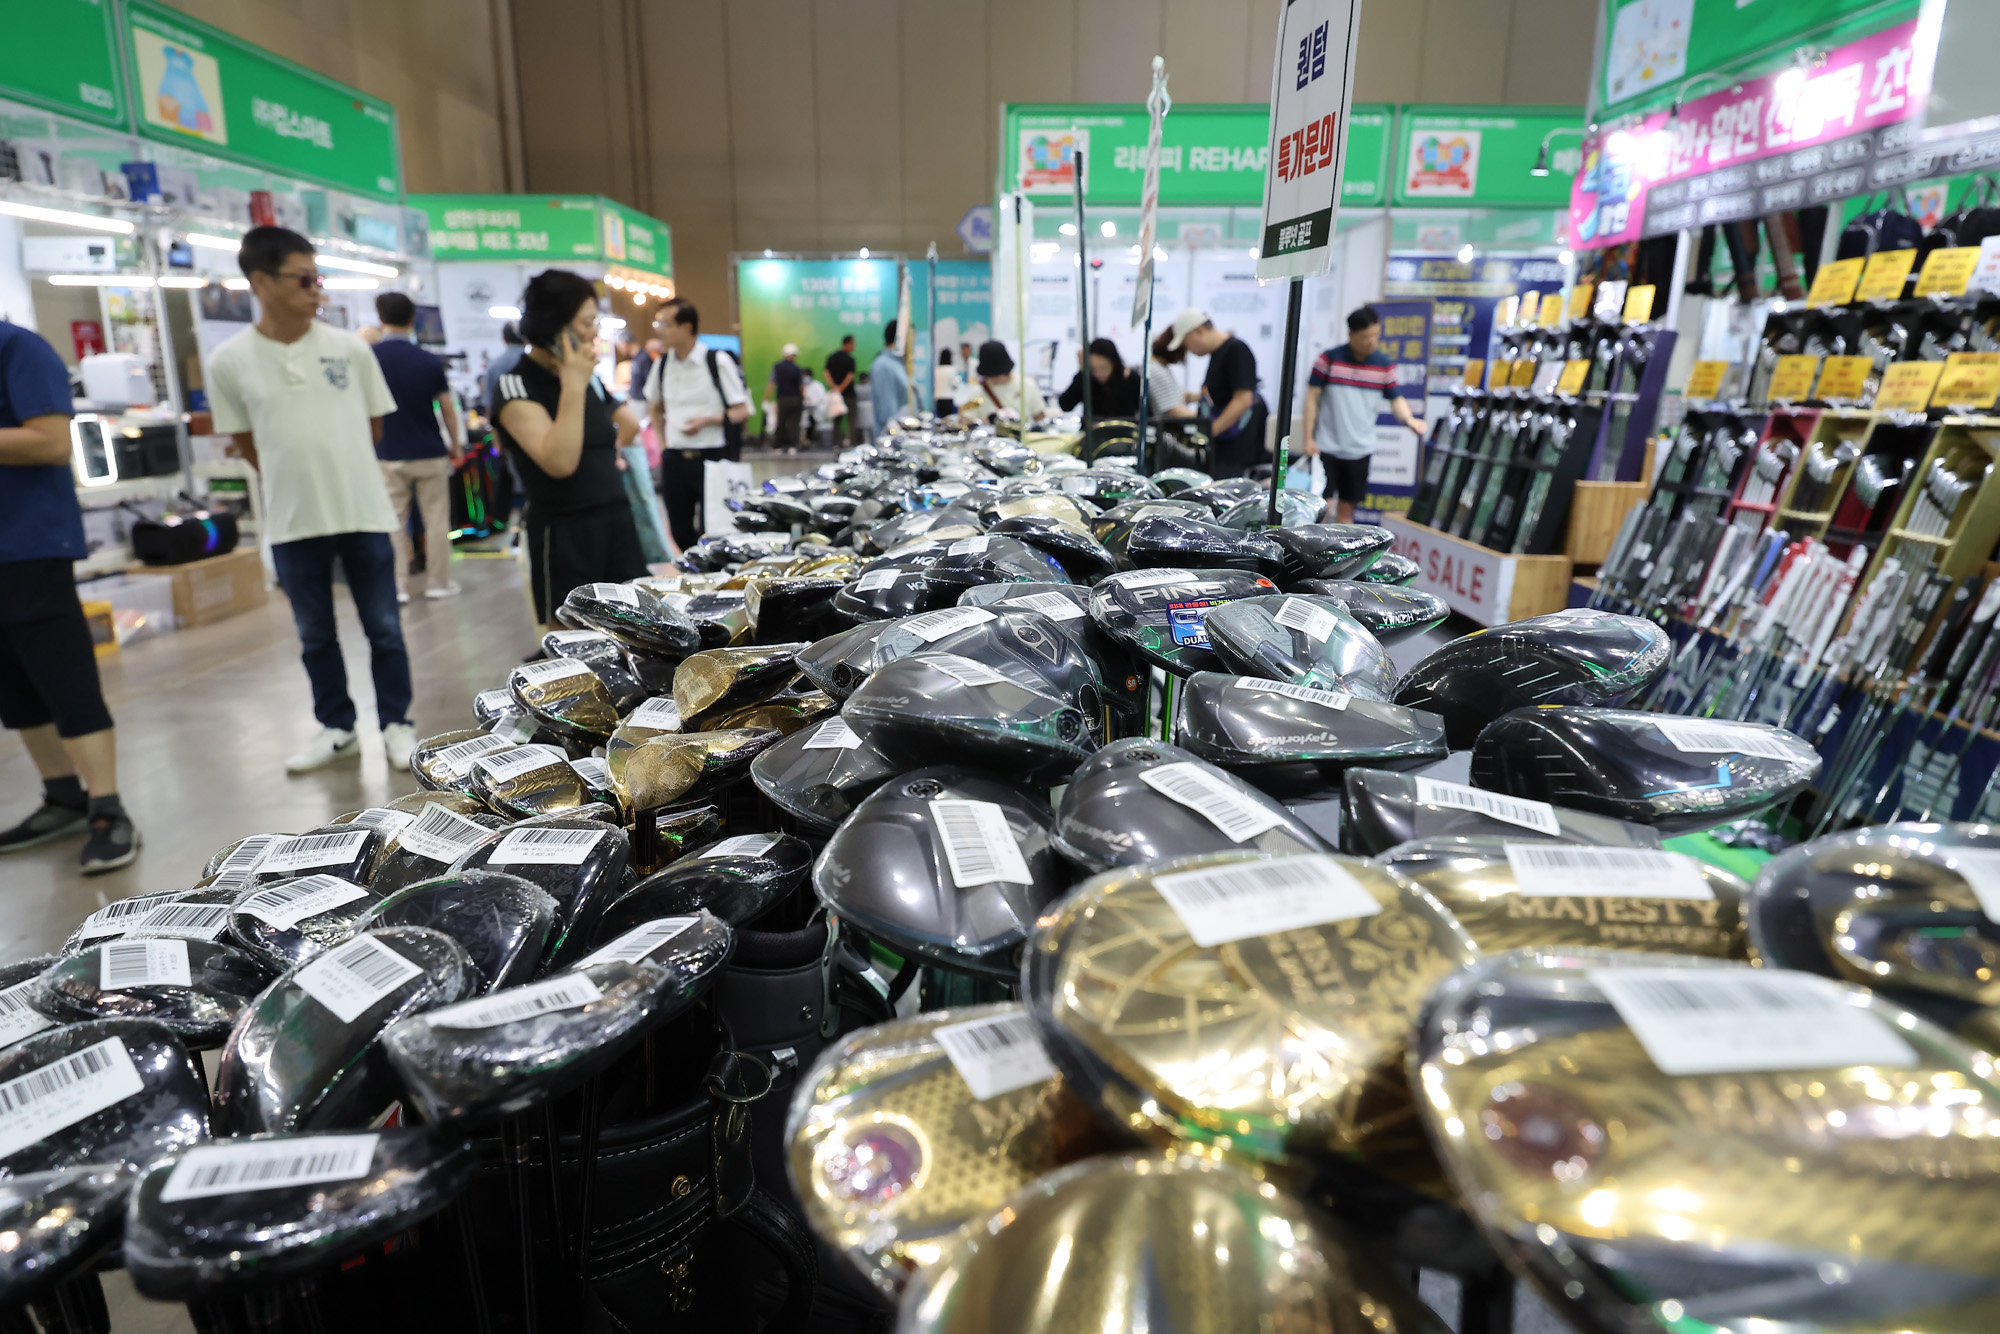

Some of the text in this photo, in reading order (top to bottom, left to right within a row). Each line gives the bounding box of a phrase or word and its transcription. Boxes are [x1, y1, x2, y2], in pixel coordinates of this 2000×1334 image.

[1278, 111, 1336, 184] 특가문의
[1278, 221, 1312, 250] 블루넷 골프
[1427, 547, 1486, 604] SALE
[1133, 583, 1227, 605] PING
[1183, 635, 1209, 646] DUAL
[1247, 731, 1339, 747] TaylorMade
[1506, 896, 1720, 926] MAJESTY
